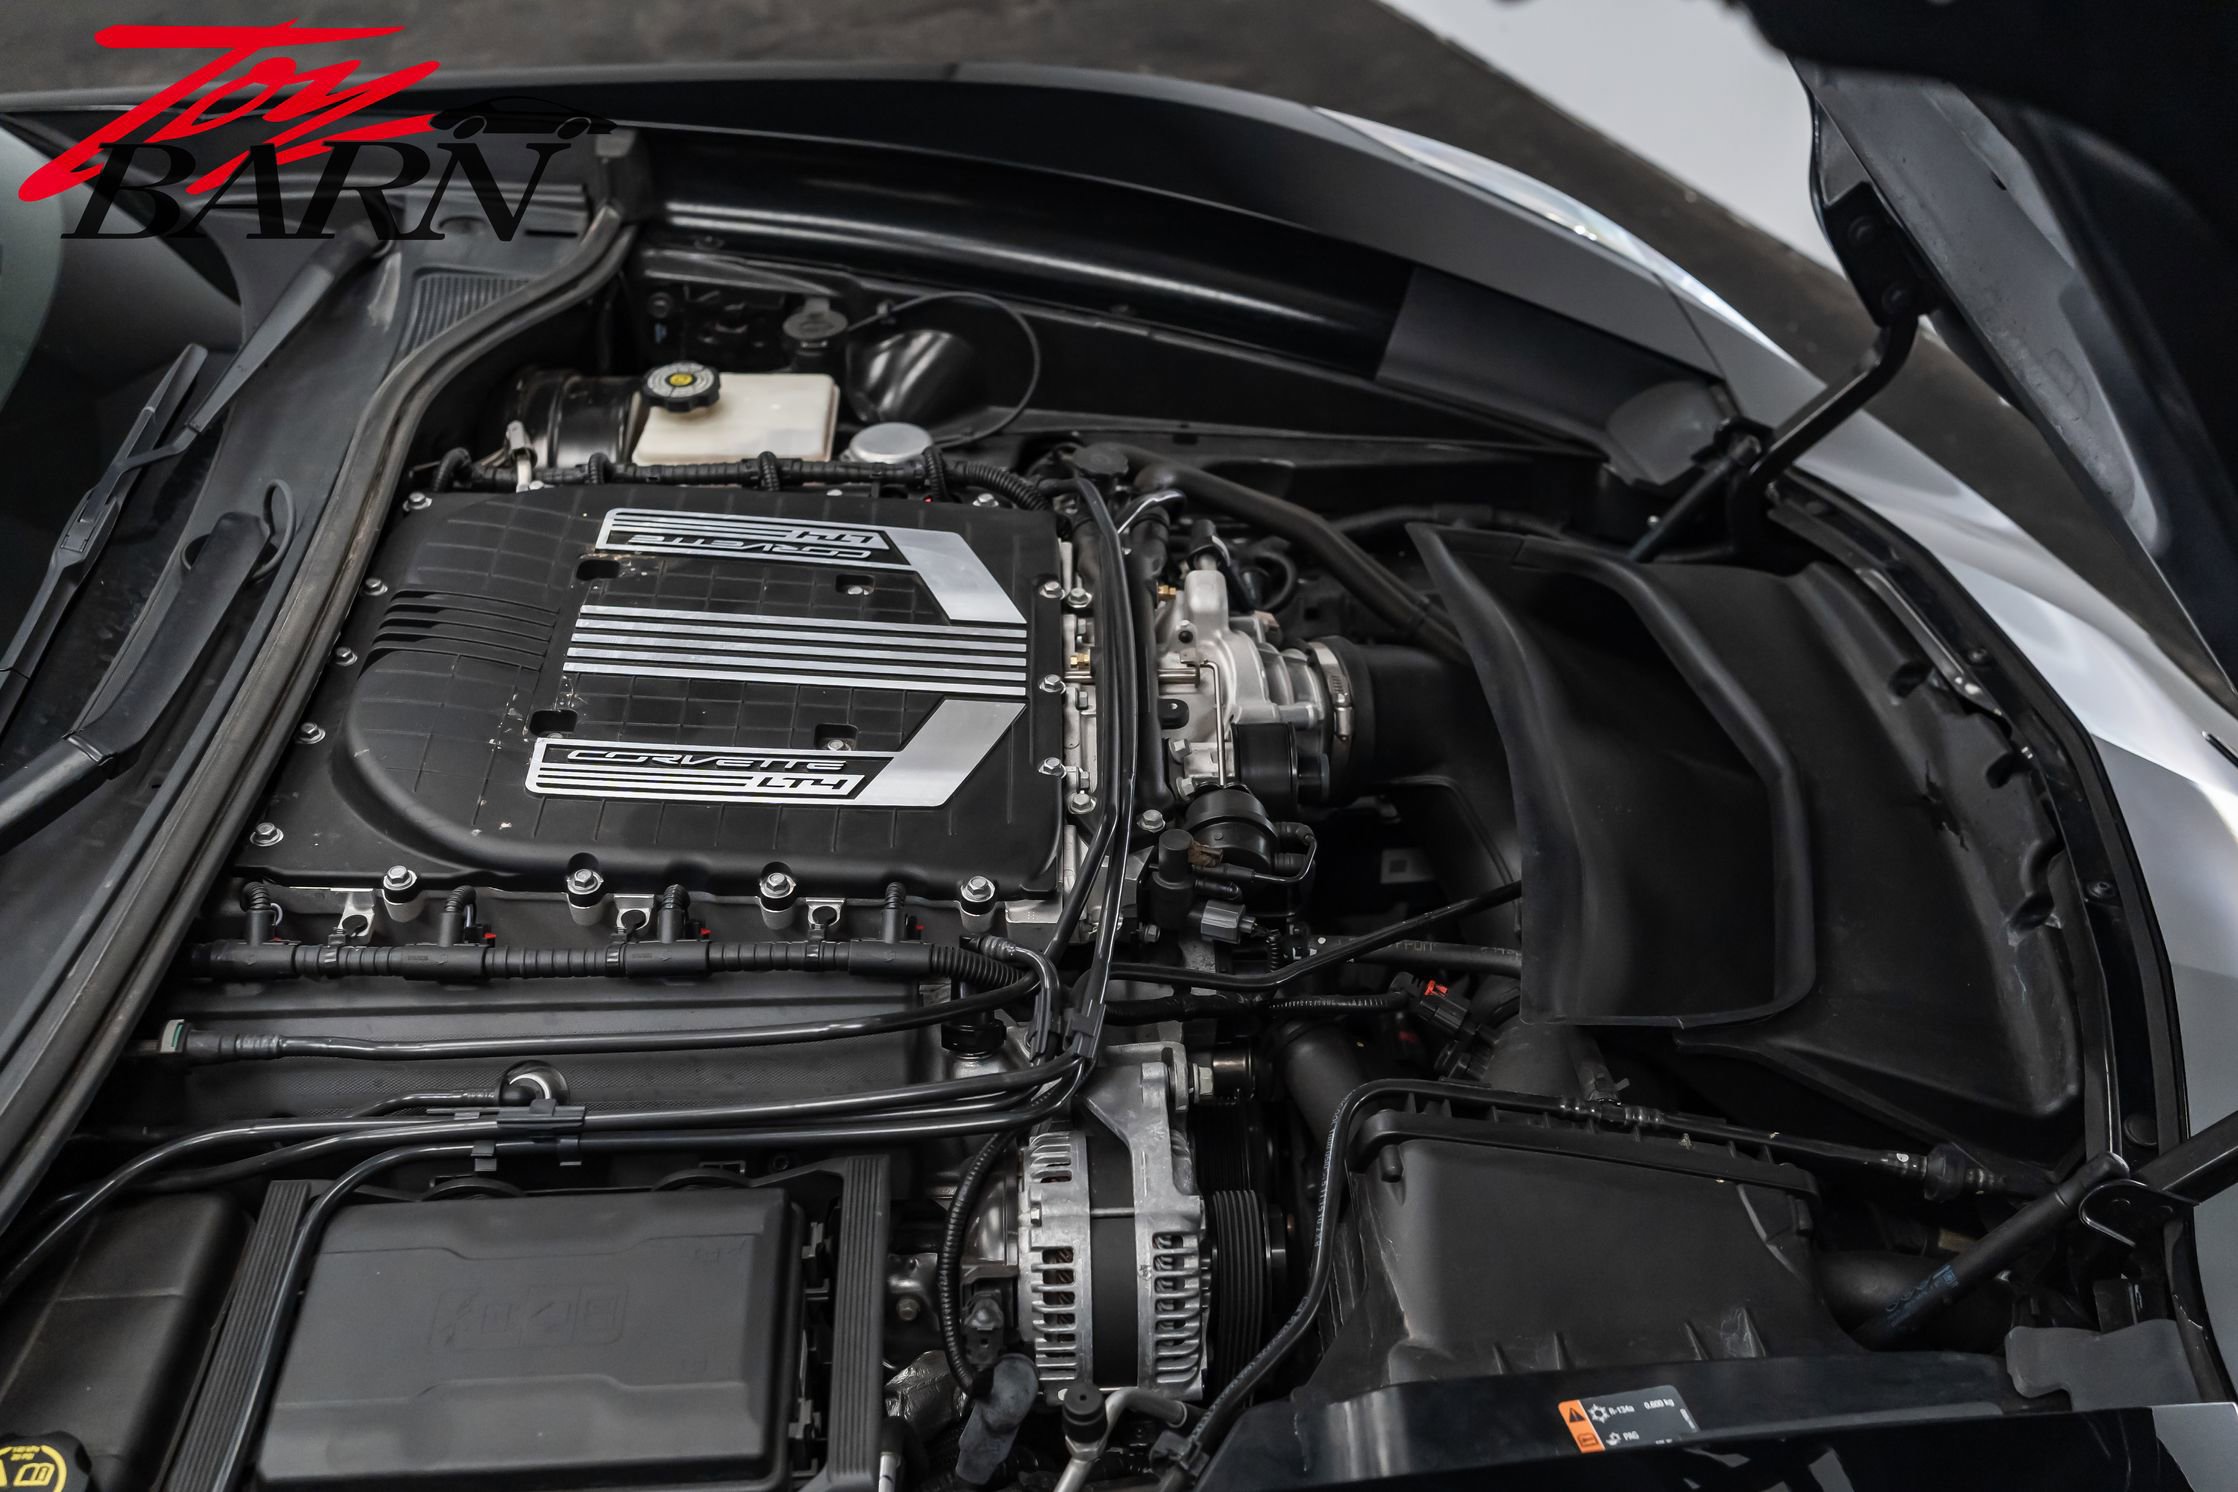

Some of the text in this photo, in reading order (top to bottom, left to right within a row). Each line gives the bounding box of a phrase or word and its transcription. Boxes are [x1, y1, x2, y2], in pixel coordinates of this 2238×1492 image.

[792, 531, 875, 544] LT4
[627, 534, 872, 559] CORVETTE
[567, 750, 847, 771] CORVETTE
[756, 775, 849, 790] LT4
[1663, 1399, 1675, 1408] kg
